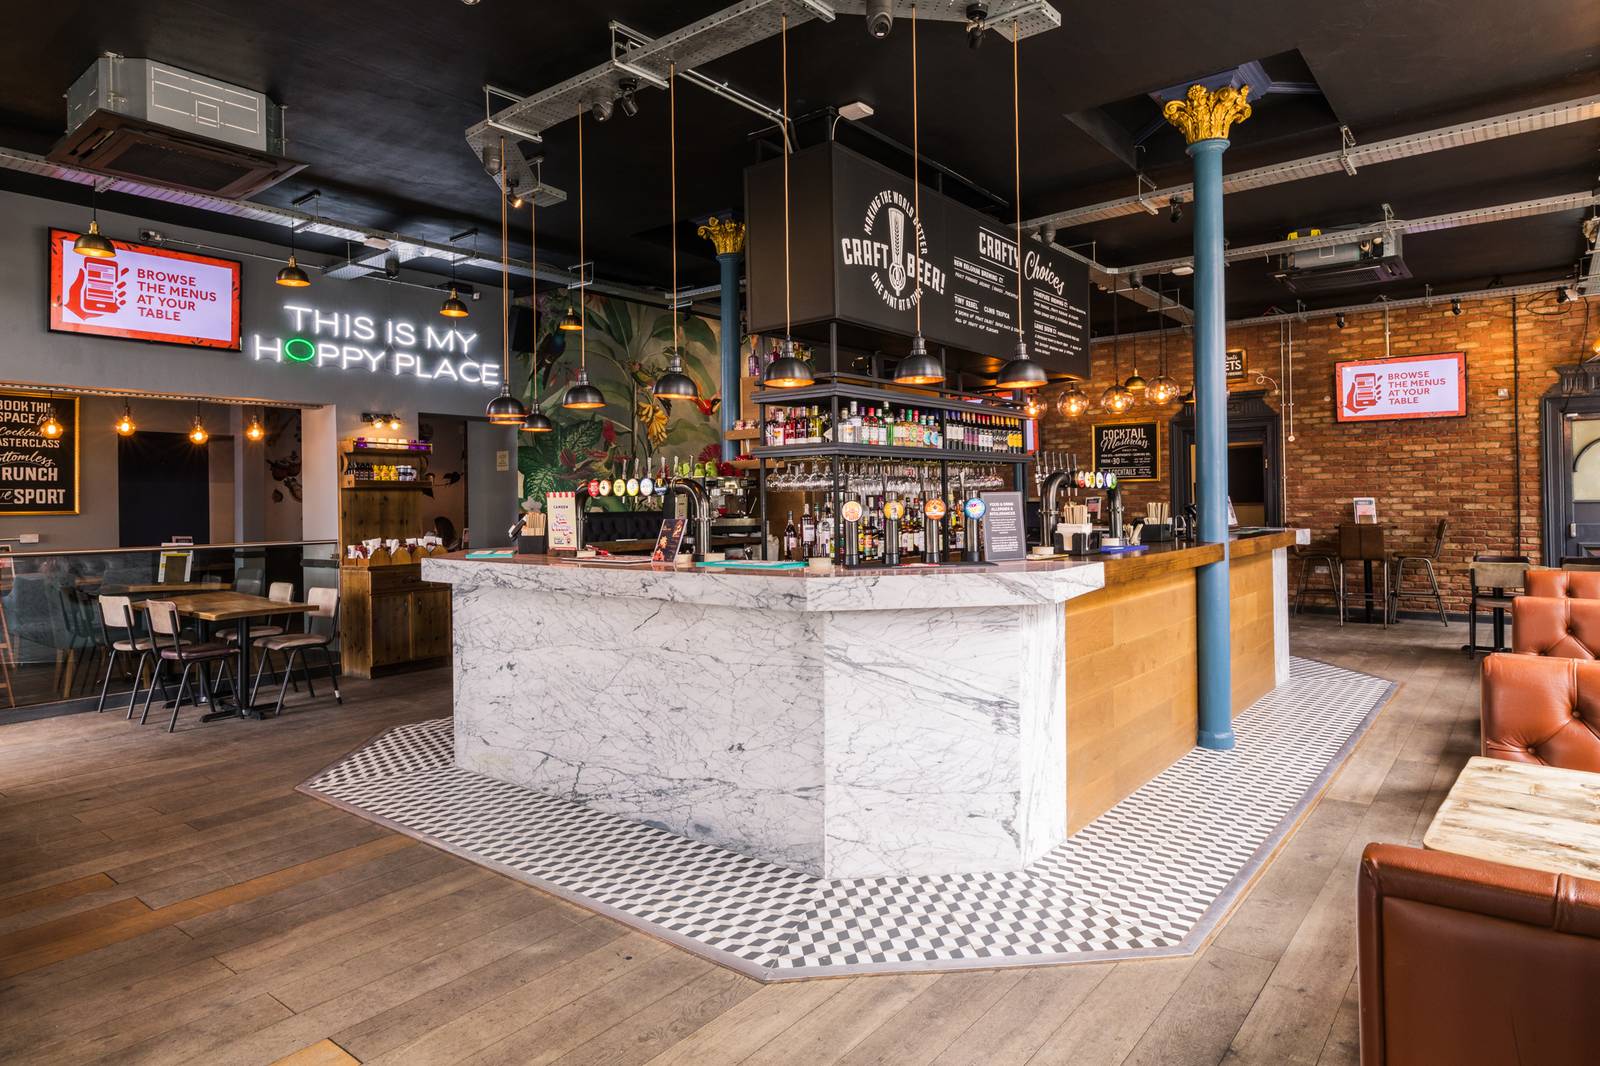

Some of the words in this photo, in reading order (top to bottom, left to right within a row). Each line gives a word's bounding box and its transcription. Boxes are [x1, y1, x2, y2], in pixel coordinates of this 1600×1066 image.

[864, 196, 882, 236] MAKING
[880, 190, 892, 204] THE
[892, 190, 914, 218] WORLD
[841, 238, 888, 269] CRAFT
[907, 252, 946, 295] BEER!
[979, 232, 1020, 268] CRAFTY
[1024, 251, 1064, 296] Choices
[137, 268, 196, 286] BROWSE
[137, 281, 165, 295] THE
[170, 286, 217, 302] MENUS
[870, 272, 884, 295] ONE
[882, 290, 897, 309] PINT
[137, 294, 155, 305] AT
[158, 298, 196, 311] YOUR
[138, 307, 181, 321] TABLE
[283, 305, 375, 340] THIS
[387, 320, 416, 346] IS
[426, 325, 478, 354] MY
[254, 334, 386, 372] HOPPY
[395, 353, 500, 386] PLACE
[1388, 371, 1430, 380] BROWSE
[1388, 380, 1410, 389] THE
[1410, 378, 1446, 387] MENUS
[1388, 389, 1400, 397] AT
[1402, 387, 1430, 396] YOUR
[30, 401, 51, 413] THI
[1389, 397, 1419, 405] TABLE
[1102, 428, 1146, 440] COCKTAIL
[1100, 436, 1148, 452] Masterclass
[14, 488, 66, 504] SPORT
